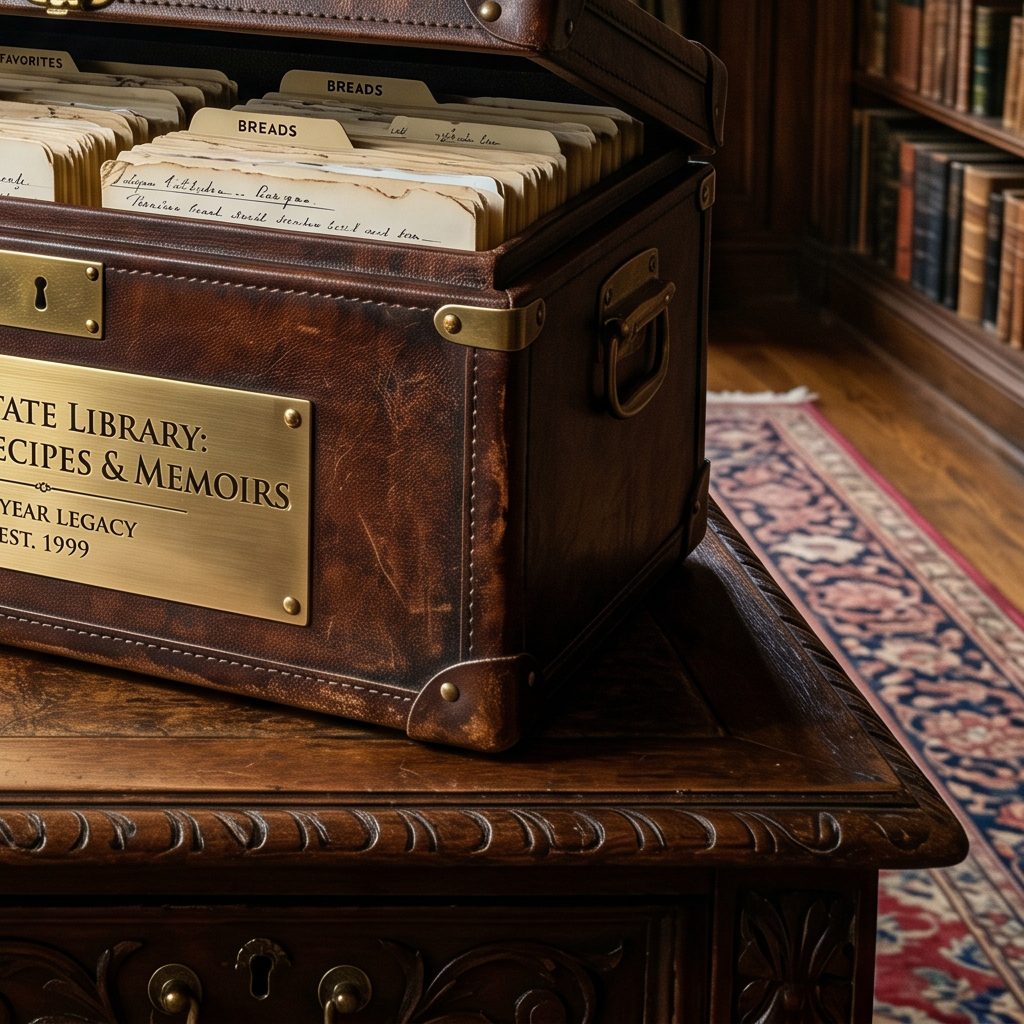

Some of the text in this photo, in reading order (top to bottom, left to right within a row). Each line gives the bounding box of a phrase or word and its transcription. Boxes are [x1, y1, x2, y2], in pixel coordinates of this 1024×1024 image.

[0, 53, 63, 69] FAVORITES
[327, 79, 383, 97] BREADS
[238, 119, 297, 138] BREADS
[67, 401, 208, 453] LIBRARY:
[101, 450, 126, 483] &
[134, 455, 291, 511] MEMOIRS
[56, 508, 138, 539] LEGACY
[42, 534, 90, 559] 1999
